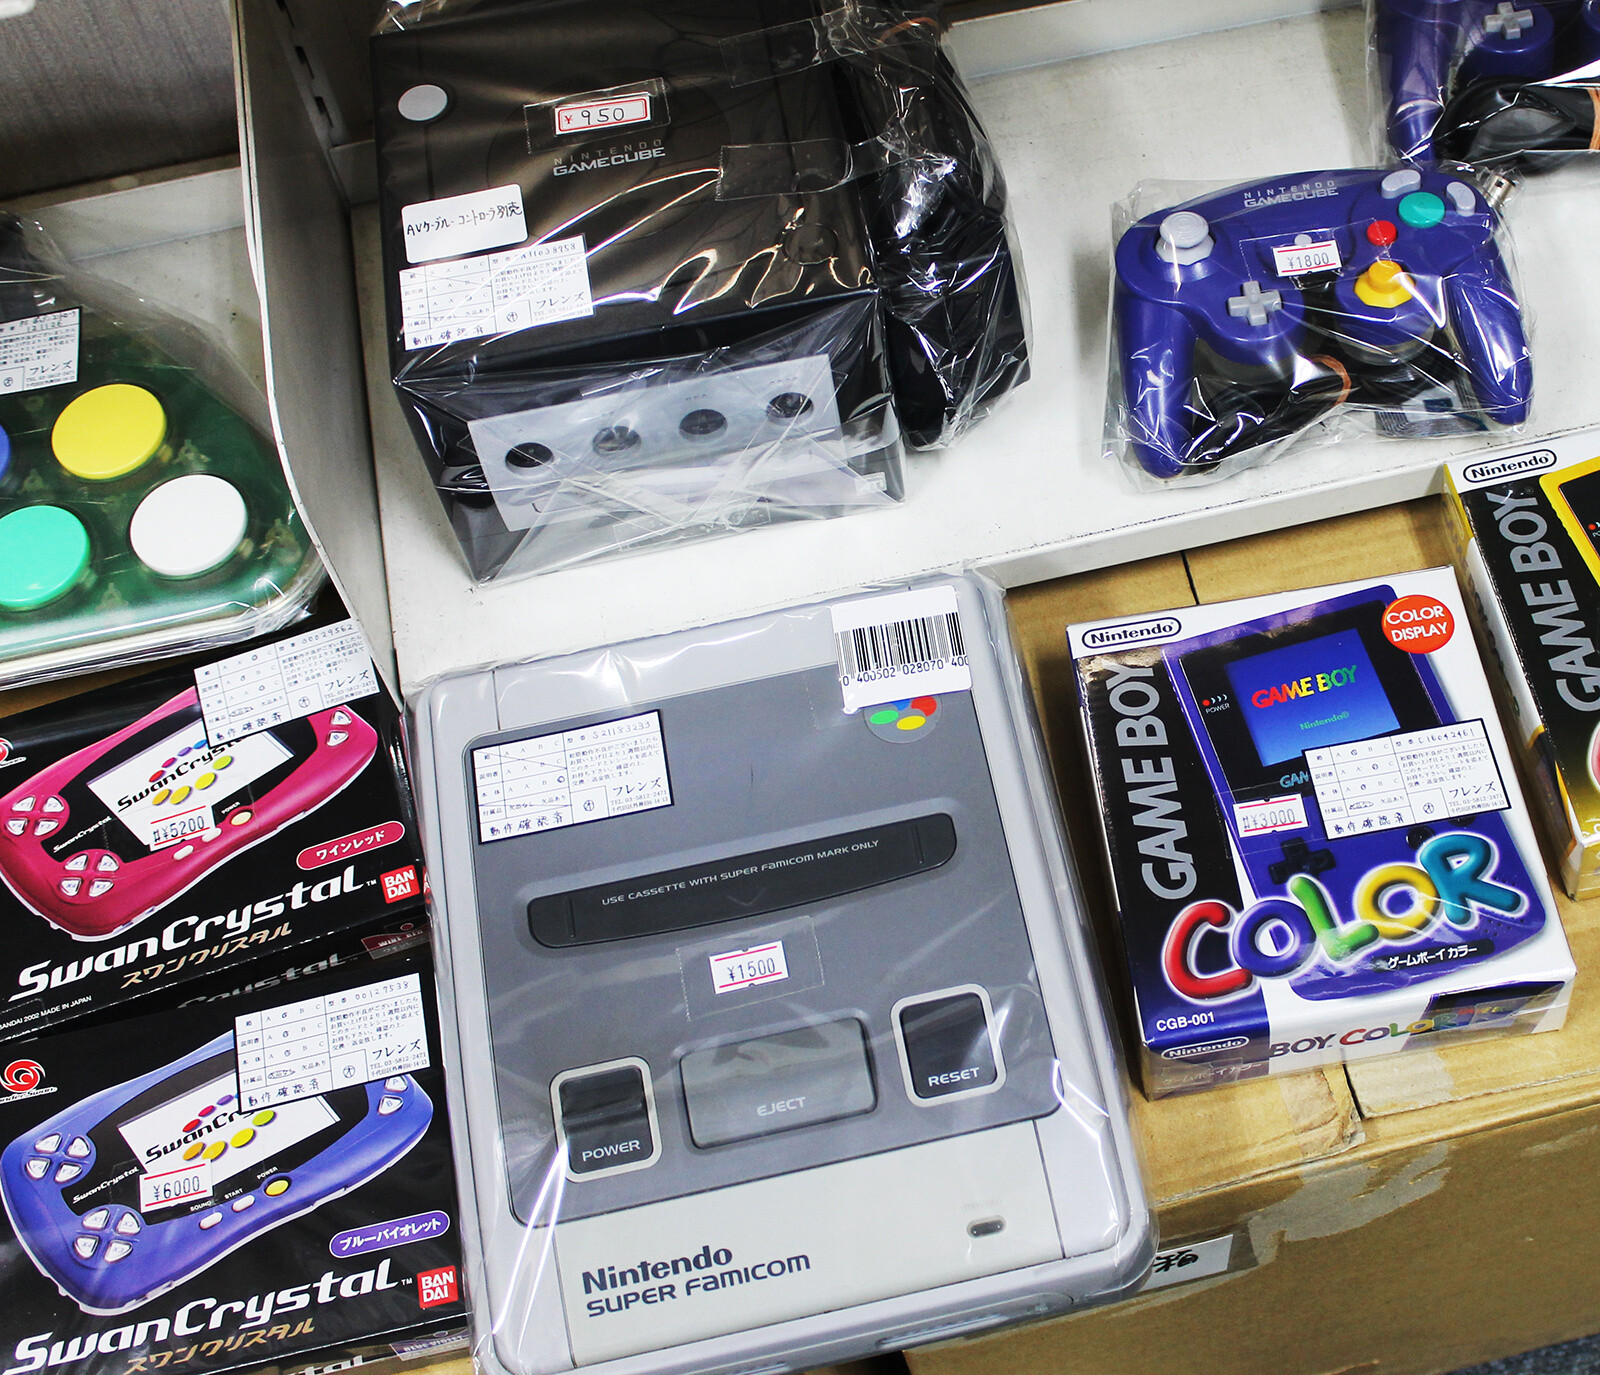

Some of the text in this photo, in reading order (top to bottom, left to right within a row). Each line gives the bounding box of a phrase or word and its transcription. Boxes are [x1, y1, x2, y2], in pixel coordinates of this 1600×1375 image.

[564, 106, 626, 126] ¥ 950
[553, 147, 666, 176] GAMECUBE
[554, 138, 662, 164] NINTENDO
[1244, 180, 1335, 199] NINTENDO
[1244, 187, 1339, 208] GAMECUBE
[1287, 252, 1330, 270] ¥1800
[536, 291, 584, 309] フレンズ
[1472, 453, 1549, 480] Nintendo
[1485, 491, 1563, 573] BOY
[1386, 605, 1445, 624] COLOR
[1090, 621, 1174, 646] Nintendo
[1391, 622, 1448, 642] DISPLAY
[1519, 579, 1600, 712] GAME
[902, 660, 944, 675] 028070
[324, 669, 370, 692] フレンズ
[1252, 664, 1357, 709] GAME BOY
[1102, 660, 1168, 747] BOY
[1205, 703, 1230, 714] POWER
[118, 737, 247, 813] SwanCrys
[612, 776, 661, 796] フレンズ
[1447, 781, 1496, 798] フレンズ
[53, 816, 112, 854] SwanCrystal
[1120, 757, 1197, 900] GAME
[316, 830, 386, 868] ワインレッド
[602, 894, 624, 906] USE
[628, 881, 686, 900] CASSETTE
[689, 875, 717, 886] WITH
[720, 866, 758, 881] SUPER
[816, 846, 849, 860] MARK
[851, 839, 880, 851] ONLY
[1165, 833, 1524, 1003] COLOR
[9, 865, 364, 1002] SwanCrystal
[121, 922, 292, 990] スワンクリスタル
[1388, 943, 1478, 970] ゲームボーイ カラー
[726, 958, 776, 982] ¥1500
[24, 1012, 40, 1022] 2002
[40, 1005, 60, 1016] MADE
[62, 1002, 70, 1010] IN
[70, 996, 92, 1008] JAPAN
[1156, 1012, 1215, 1032] CGB-001
[372, 1038, 421, 1060] フレンズ
[384, 1051, 426, 1066] 03-5812-2471
[1169, 1039, 1242, 1058] Nintendo
[928, 1068, 980, 1087] RESET
[756, 1096, 806, 1116] EJECT
[582, 1140, 642, 1162] POWER
[72, 1166, 140, 1204] SwanCrystal
[153, 1175, 200, 1200] ¥6000
[224, 1188, 244, 1199] START
[340, 1218, 441, 1250] ブルーバイオレット
[582, 1245, 733, 1295] Nintendo
[586, 1284, 676, 1318] SUPER
[3, 1258, 398, 1375] SwanCrystal
[126, 1318, 315, 1374] スワンクリスタル
